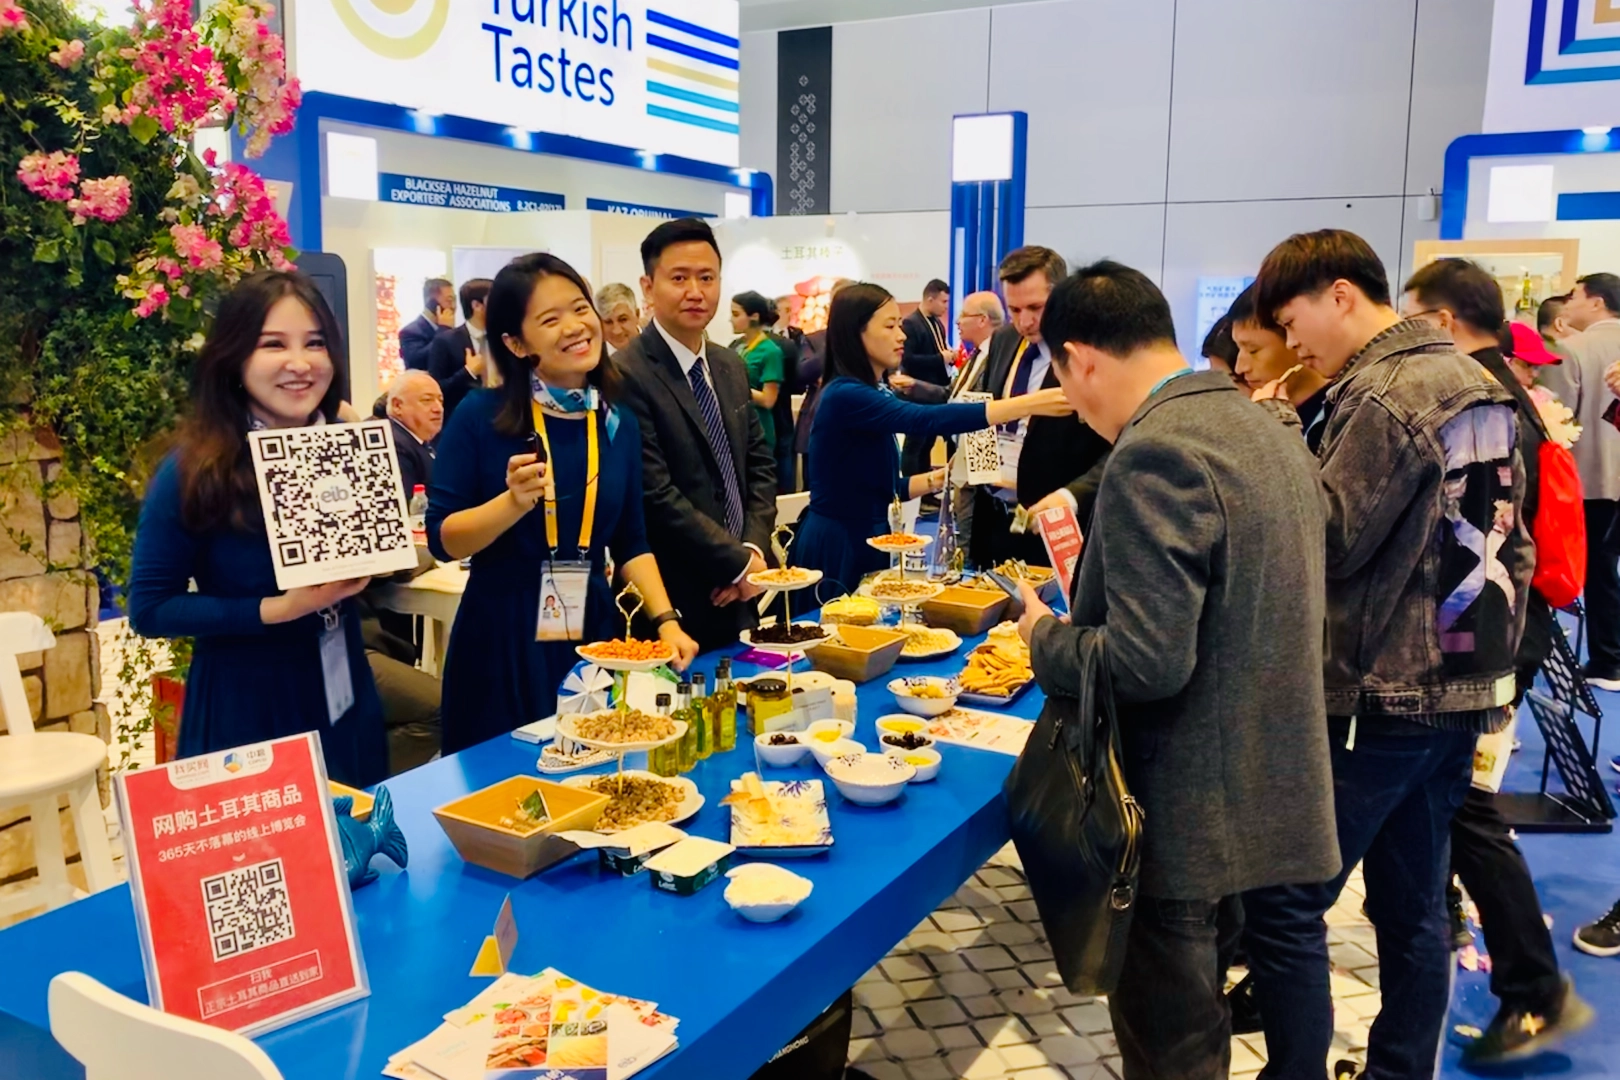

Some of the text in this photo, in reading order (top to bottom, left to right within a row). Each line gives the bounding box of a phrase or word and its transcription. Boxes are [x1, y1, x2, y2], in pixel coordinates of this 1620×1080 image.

[494, 0, 633, 52] urkish
[481, 22, 616, 106] Tastes
[390, 188, 447, 205] EXPORTERS'
[449, 195, 511, 212] ASSOCIATIONS
[405, 177, 498, 199] BLACKSEA HAZELNUT
[320, 486, 349, 503] eib
[152, 784, 303, 840] 网购土耳其商品
[158, 814, 307, 863] 365天不落幕的线上博览会
